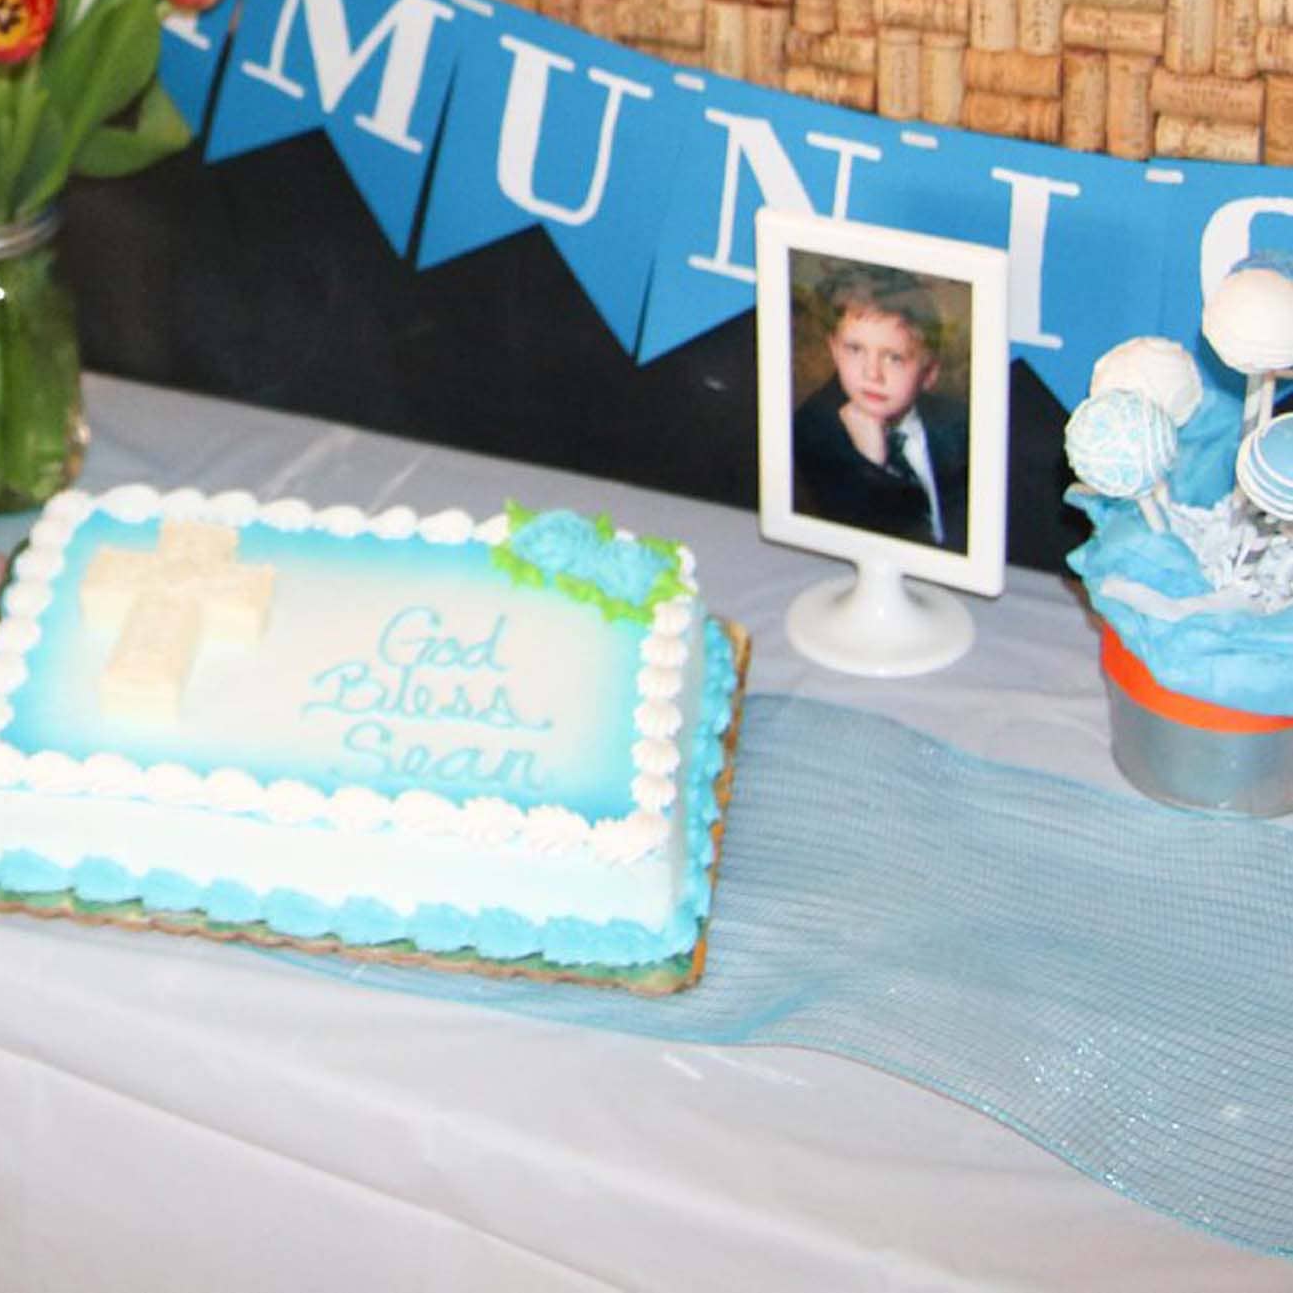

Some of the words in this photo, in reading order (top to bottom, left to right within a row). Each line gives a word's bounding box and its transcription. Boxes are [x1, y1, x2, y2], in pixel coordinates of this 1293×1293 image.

[377, 605, 509, 671] God
[301, 660, 553, 732] Bless
[342, 719, 552, 792] Sean
